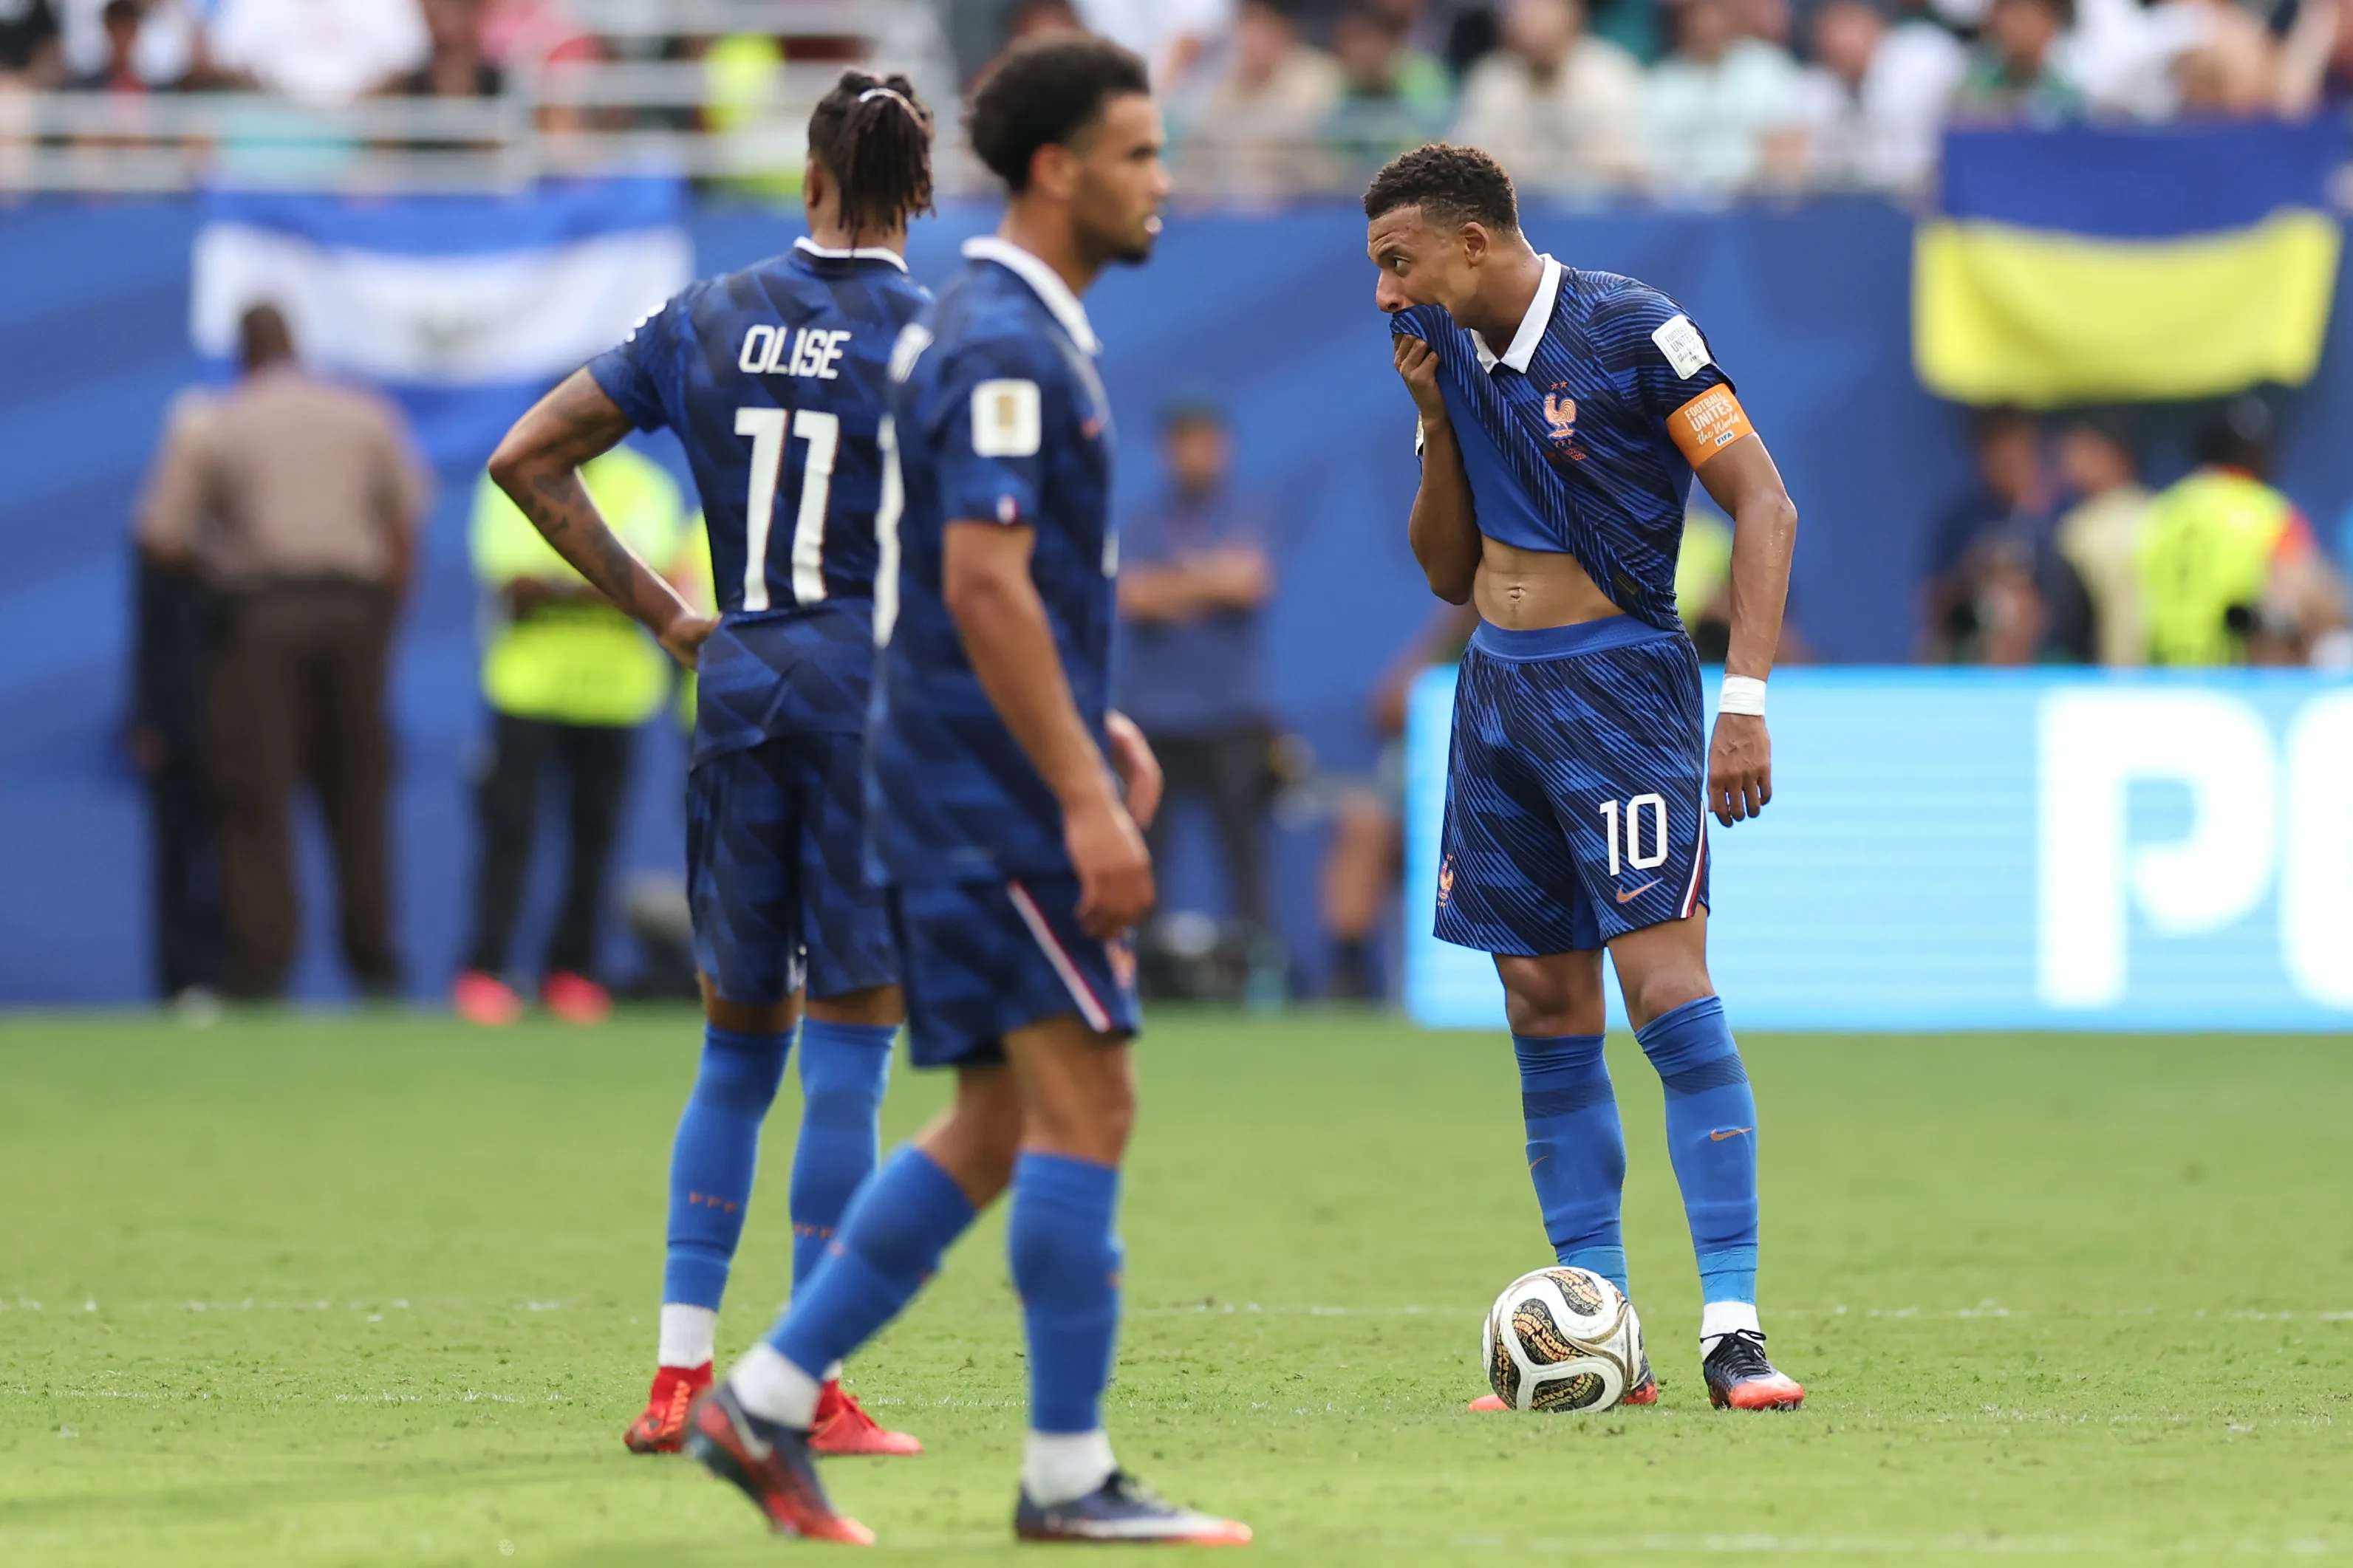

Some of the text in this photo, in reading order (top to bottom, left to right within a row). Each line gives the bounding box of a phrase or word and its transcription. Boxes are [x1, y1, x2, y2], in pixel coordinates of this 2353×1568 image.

[737, 323, 852, 380] OLISE
[1684, 391, 1725, 420] FOOTBALL
[1690, 399, 1733, 432] UNITES
[1696, 411, 1741, 445] the World
[1716, 432, 1733, 445] FIFA
[734, 406, 841, 612] 11
[1599, 792, 1669, 877] 10
[2036, 685, 2353, 1009] P
[1542, 1327, 1572, 1355] YORK
